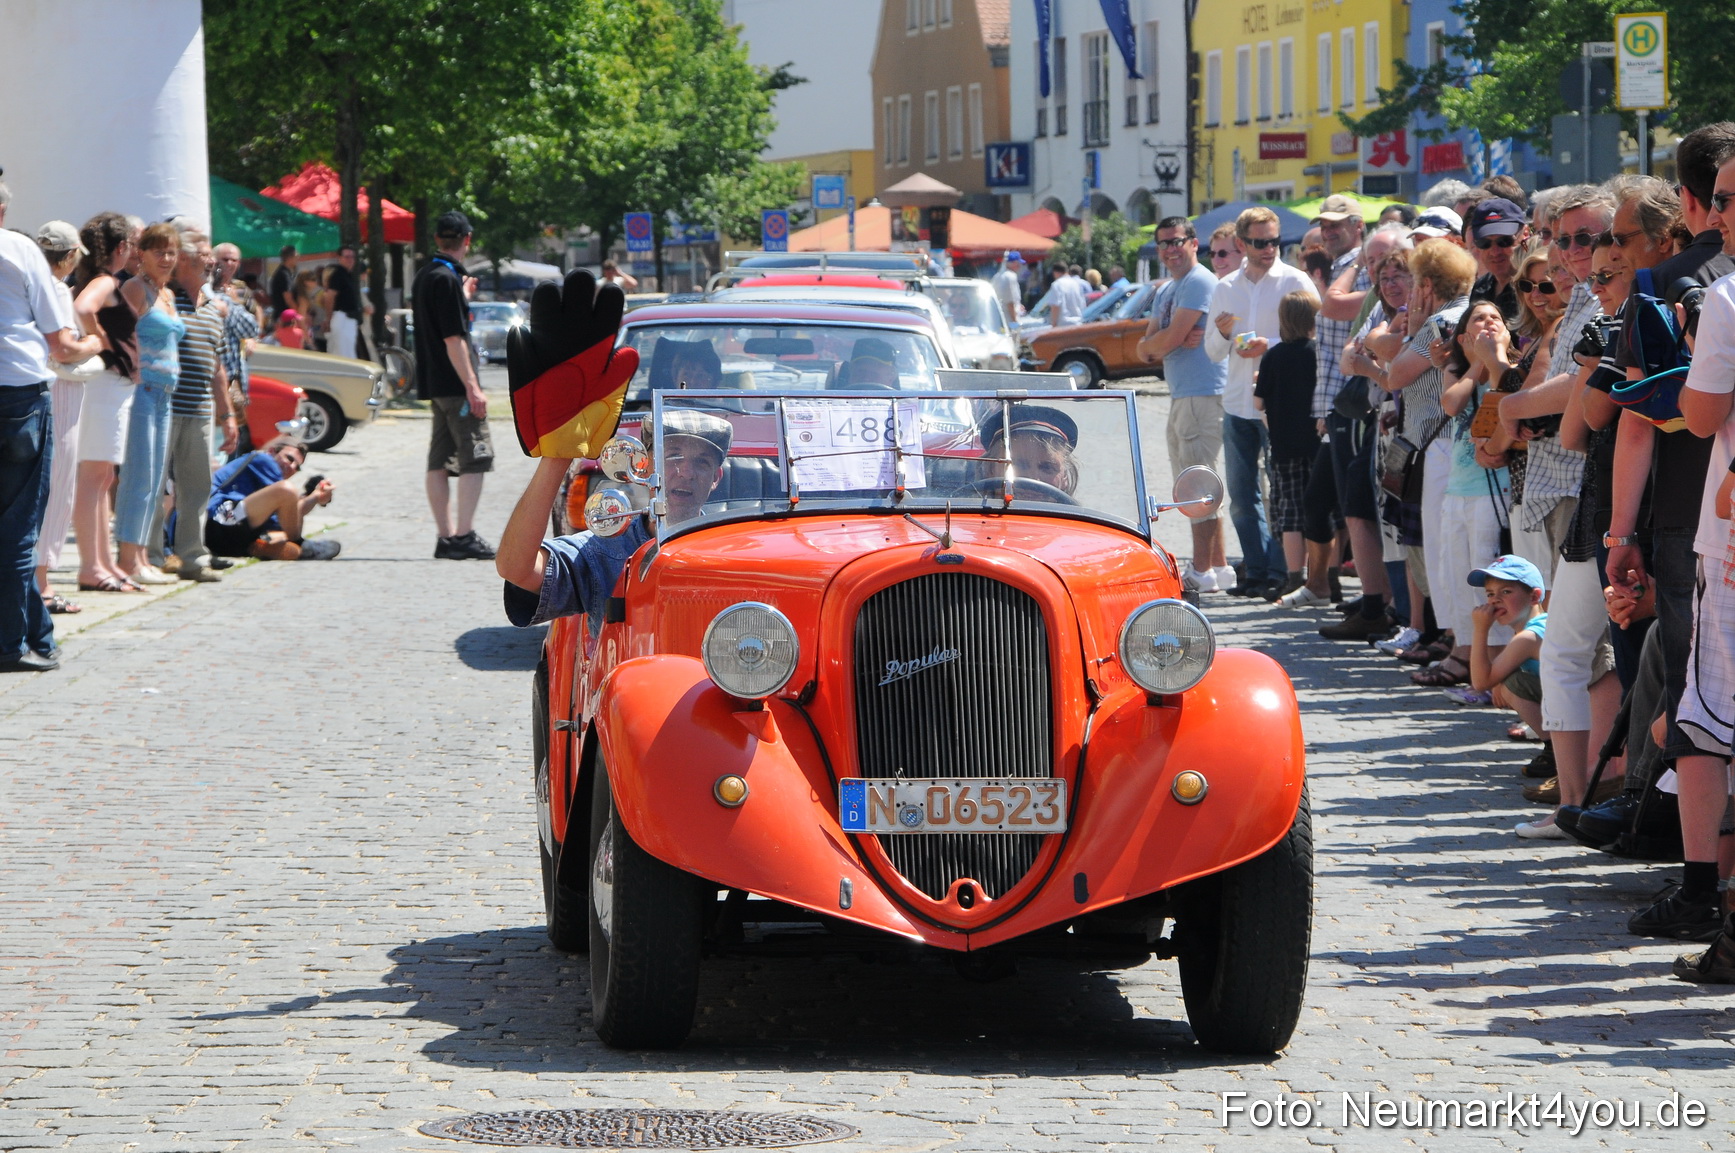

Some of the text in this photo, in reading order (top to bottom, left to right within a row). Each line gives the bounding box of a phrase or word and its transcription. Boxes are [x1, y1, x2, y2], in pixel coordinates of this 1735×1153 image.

[1242, 4, 1269, 34] HOTEL
[1632, 29, 1650, 49] H
[836, 417, 903, 443] 488
[878, 645, 962, 686] Popular
[849, 811, 859, 822] D
[869, 786, 1060, 826] N 06523
